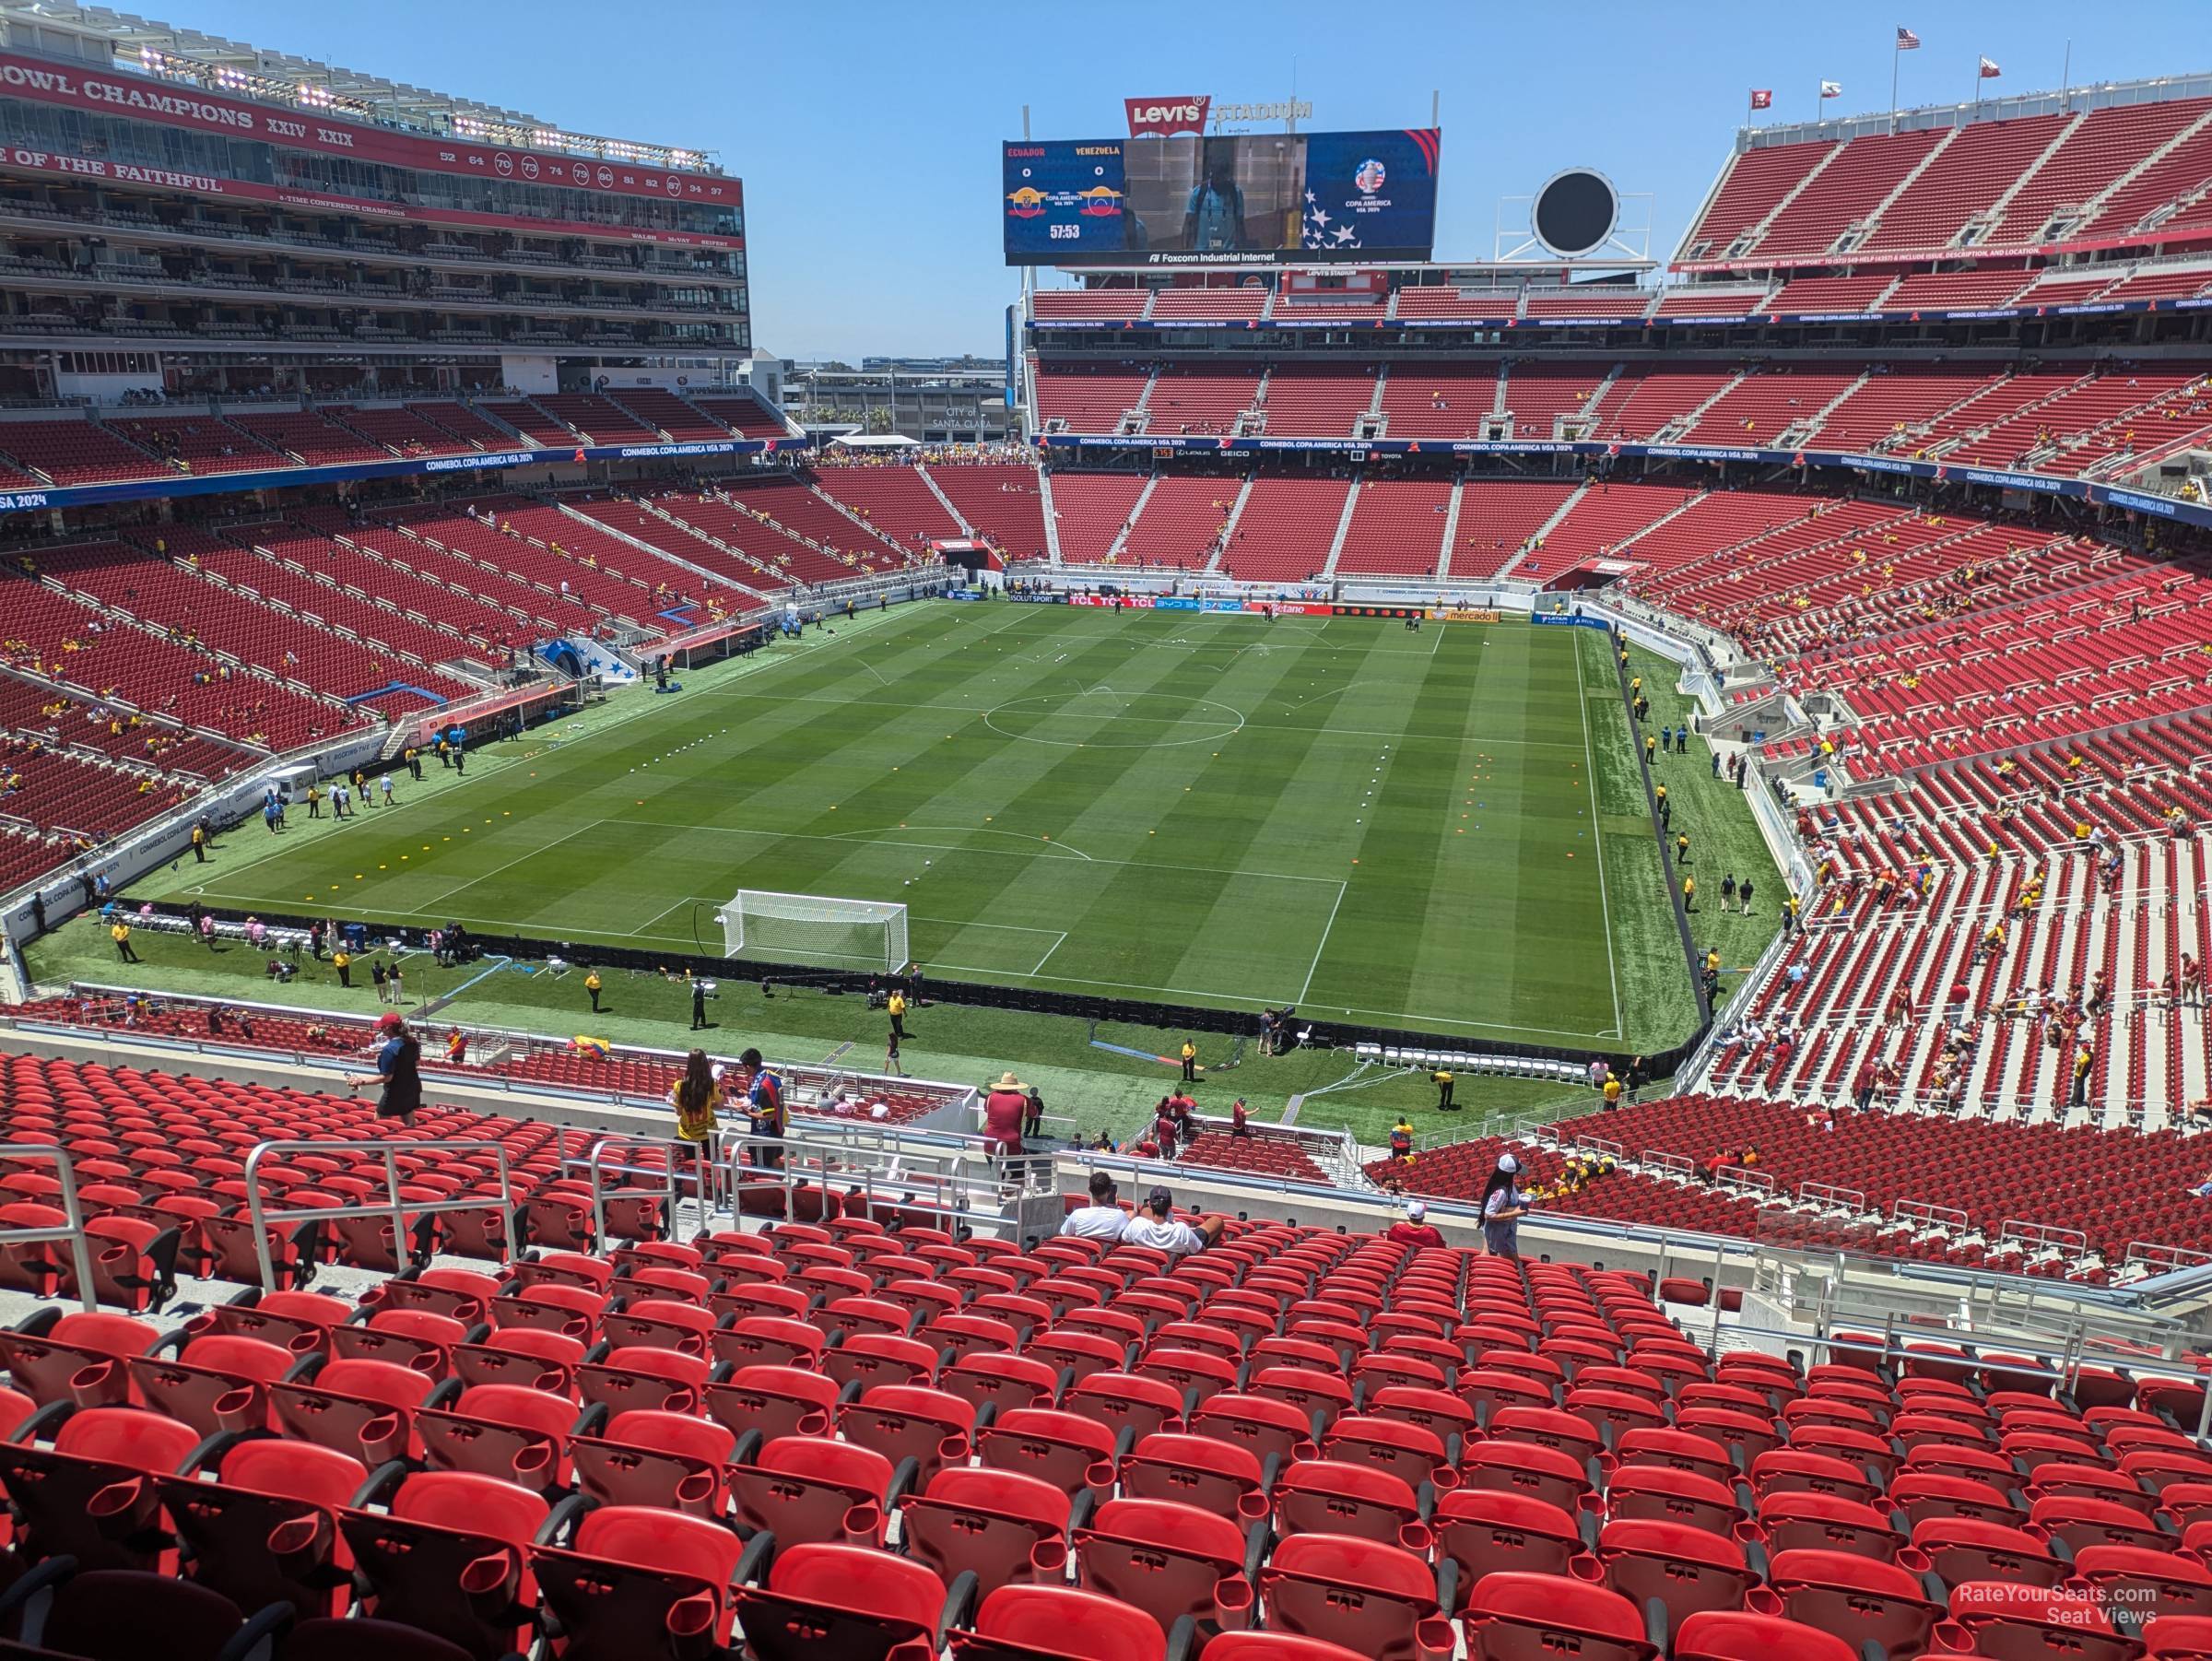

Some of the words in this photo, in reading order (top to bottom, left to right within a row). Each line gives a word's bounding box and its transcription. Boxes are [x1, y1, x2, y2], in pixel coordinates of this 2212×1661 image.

[84, 80, 253, 128] CHAMPIONS
[1215, 101, 1312, 122] STADIUM
[265, 118, 306, 138] XXIV
[317, 128, 354, 147] XXIX
[1007, 147, 1045, 157] ECUADOR
[1076, 147, 1121, 156] VENEZUELA
[495, 159, 512, 169] 70
[523, 162, 537, 172] 73
[15, 150, 47, 168] OF
[55, 155, 106, 176] THE
[114, 164, 223, 193] FAITHFUL
[1022, 168, 1031, 177] 0
[1094, 166, 1104, 176] 0
[311, 198, 360, 211] CONFERENCE
[361, 206, 406, 217] CHAMPIONS
[631, 232, 657, 241] WALSH
[1051, 224, 1080, 239] 57:53
[1162, 254, 1198, 263] Foxconn
[1200, 253, 1241, 263] Industrial
[1241, 253, 1276, 262] Internet
[1743, 261, 1777, 269] ASSISTANCE?
[1899, 253, 1924, 261] INCLUDE
[1926, 252, 1945, 260] ISSUE,
[1946, 250, 1989, 259] DESCRIPTION,
[2006, 247, 2041, 255] LOCATION.
[946, 407, 965, 417] CITY
[968, 407, 977, 417] of
[933, 418, 960, 429] SANTA
[964, 420, 992, 429] CLARA
[622, 446, 660, 457] CONMEBOL
[660, 446, 677, 456] COPA
[677, 445, 706, 455] AMERICA
[707, 444, 719, 453] USA
[426, 459, 463, 471] CONMEBOL
[463, 459, 479, 469] COPA
[479, 456, 507, 467] AMERICA
[508, 455, 519, 465] USA
[519, 454, 533, 462] 2024
[1967, 472, 1995, 482] CONMEBOL
[1995, 474, 2010, 484] COPA
[2010, 477, 2034, 487] AMERICA
[2035, 479, 2046, 489] USA
[2046, 481, 2061, 490] 2024
[17, 494, 47, 507] 2024
[1071, 596, 1095, 606] TCL
[1130, 598, 1155, 607] TCL
[1451, 612, 1490, 621] mercado
[140, 836, 168, 855] CONMEBOL
[168, 828, 182, 839] COPA
[53, 889, 72, 902] COPA
